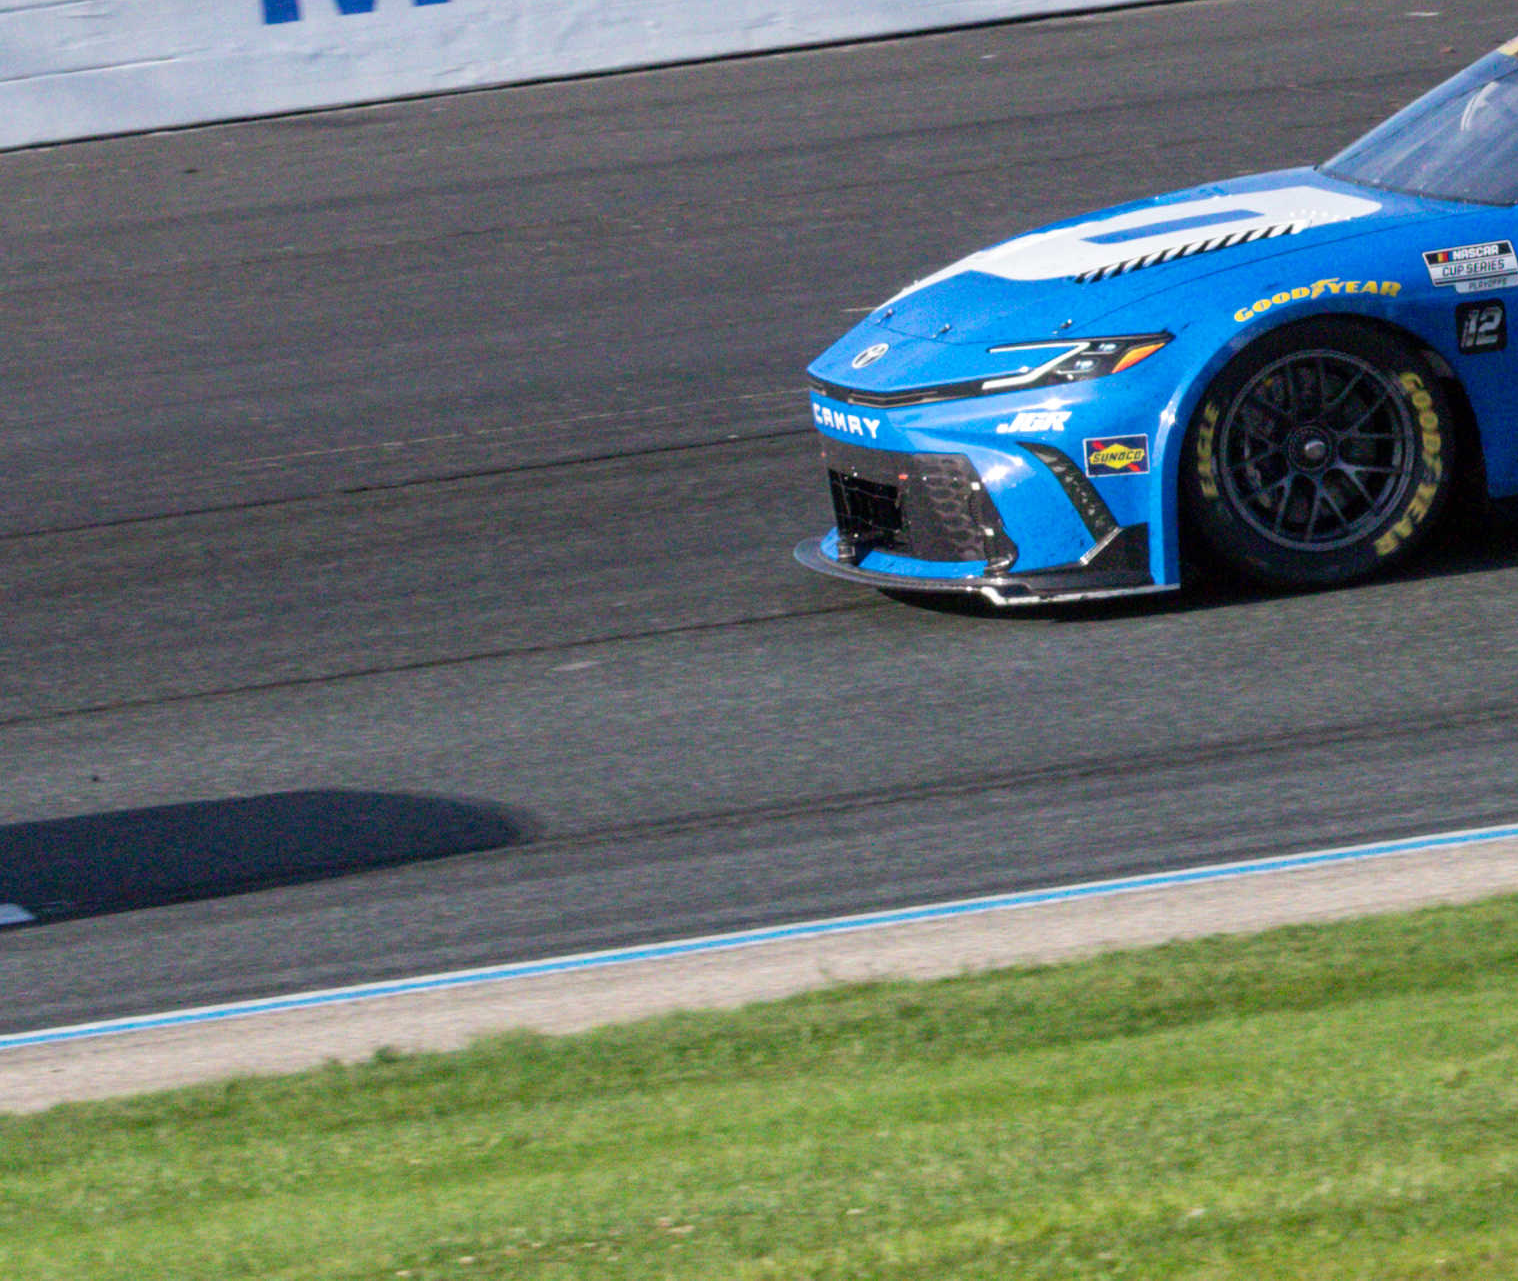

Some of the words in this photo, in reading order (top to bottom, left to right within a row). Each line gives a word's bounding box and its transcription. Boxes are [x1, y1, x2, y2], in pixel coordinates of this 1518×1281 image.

[1442, 263, 1465, 278] CUP
[1465, 258, 1505, 274] SERIES
[1451, 243, 1500, 262] NASCAR
[1233, 277, 1402, 323] GOODYEAR
[1461, 305, 1503, 348] 12
[812, 402, 880, 440] CAMRY
[995, 410, 1073, 434] JGR
[1091, 448, 1144, 465] SUNOCO
[1373, 371, 1444, 558] GOODYEAR
